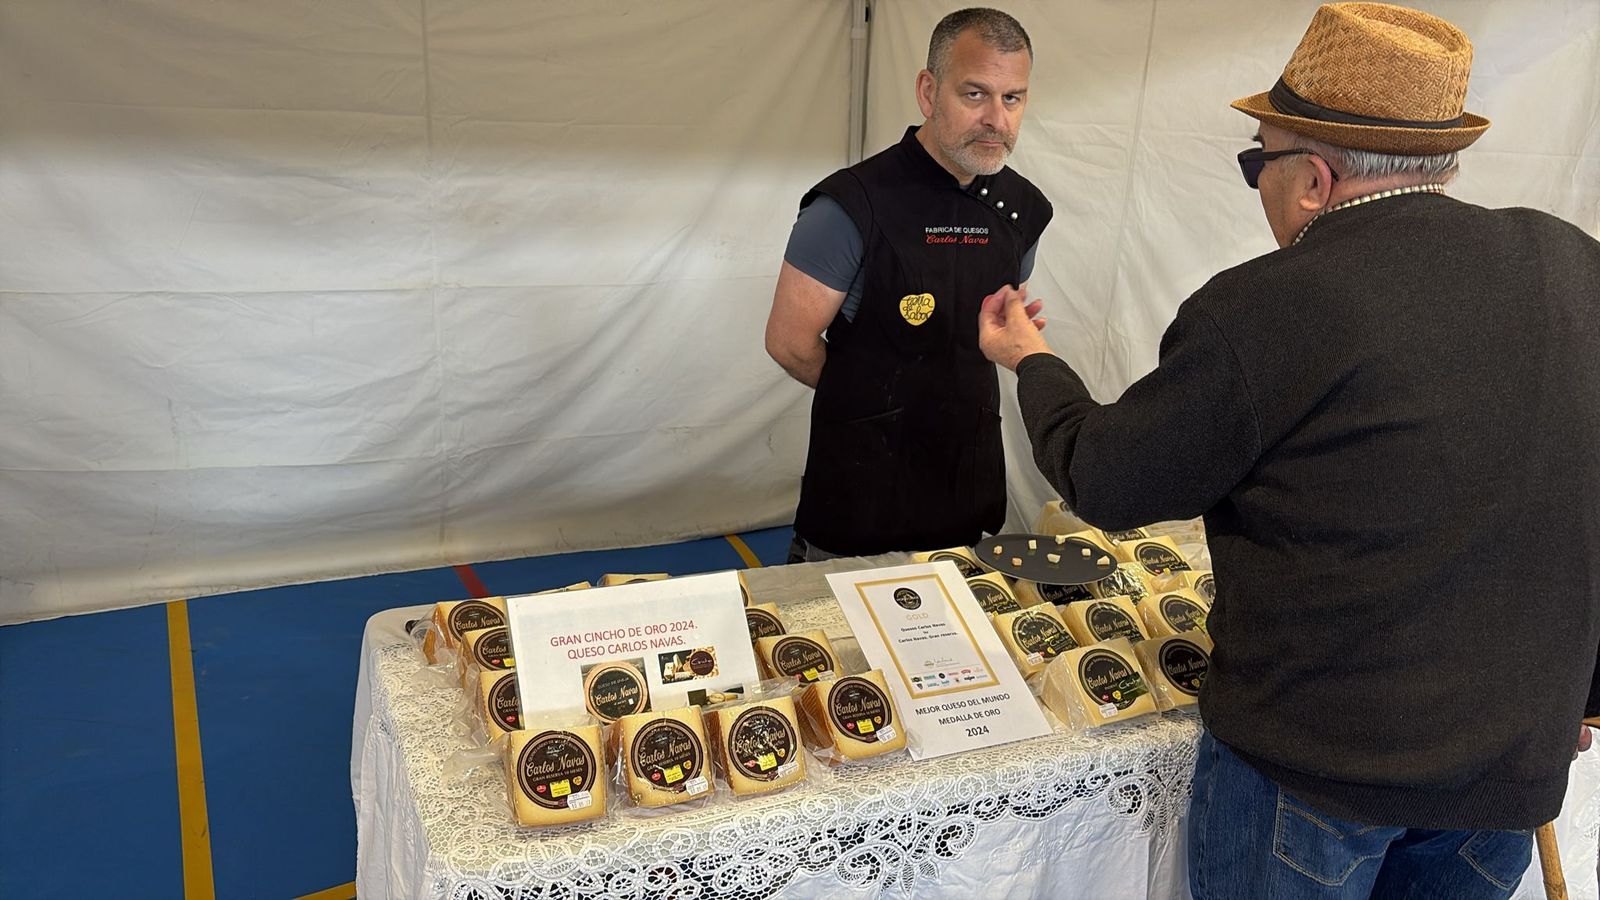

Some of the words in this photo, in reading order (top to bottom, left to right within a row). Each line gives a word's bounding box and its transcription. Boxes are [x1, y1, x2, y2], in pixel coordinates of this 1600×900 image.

[926, 234, 957, 244] Carlos
[958, 234, 988, 244] Navas
[455, 619, 478, 631] Carlos
[480, 616, 501, 628] Navas
[906, 612, 928, 620] GOLD
[550, 634, 582, 647] GRAN
[584, 629, 625, 643] CINCHO
[628, 627, 642, 638] DE
[644, 623, 668, 635] ORO
[670, 619, 698, 632] 2024.
[482, 645, 507, 655] Carlos
[567, 645, 606, 660] QUESO
[608, 641, 648, 656] CARLOS
[650, 636, 686, 649] NAVAS.
[780, 659, 802, 671] Carlos
[1087, 674, 1107, 689] Carlos
[1108, 667, 1127, 682] Navas
[497, 694, 520, 709] Carlo
[595, 692, 617, 706] Carlos
[619, 684, 638, 699] Navas
[835, 702, 858, 716] Carlos
[859, 696, 880, 711] Navas
[915, 703, 941, 716] MEJOR
[941, 700, 967, 711] QUESO
[967, 698, 981, 706] DEL
[982, 693, 1010, 704] MUNDO
[938, 713, 973, 725] MEDALLA
[985, 708, 1001, 717] ORO
[966, 725, 989, 737] 2024
[639, 749, 665, 767] Carlos
[668, 739, 691, 758] Navas
[526, 760, 555, 777] Carlos
[557, 753, 585, 771] Navas
